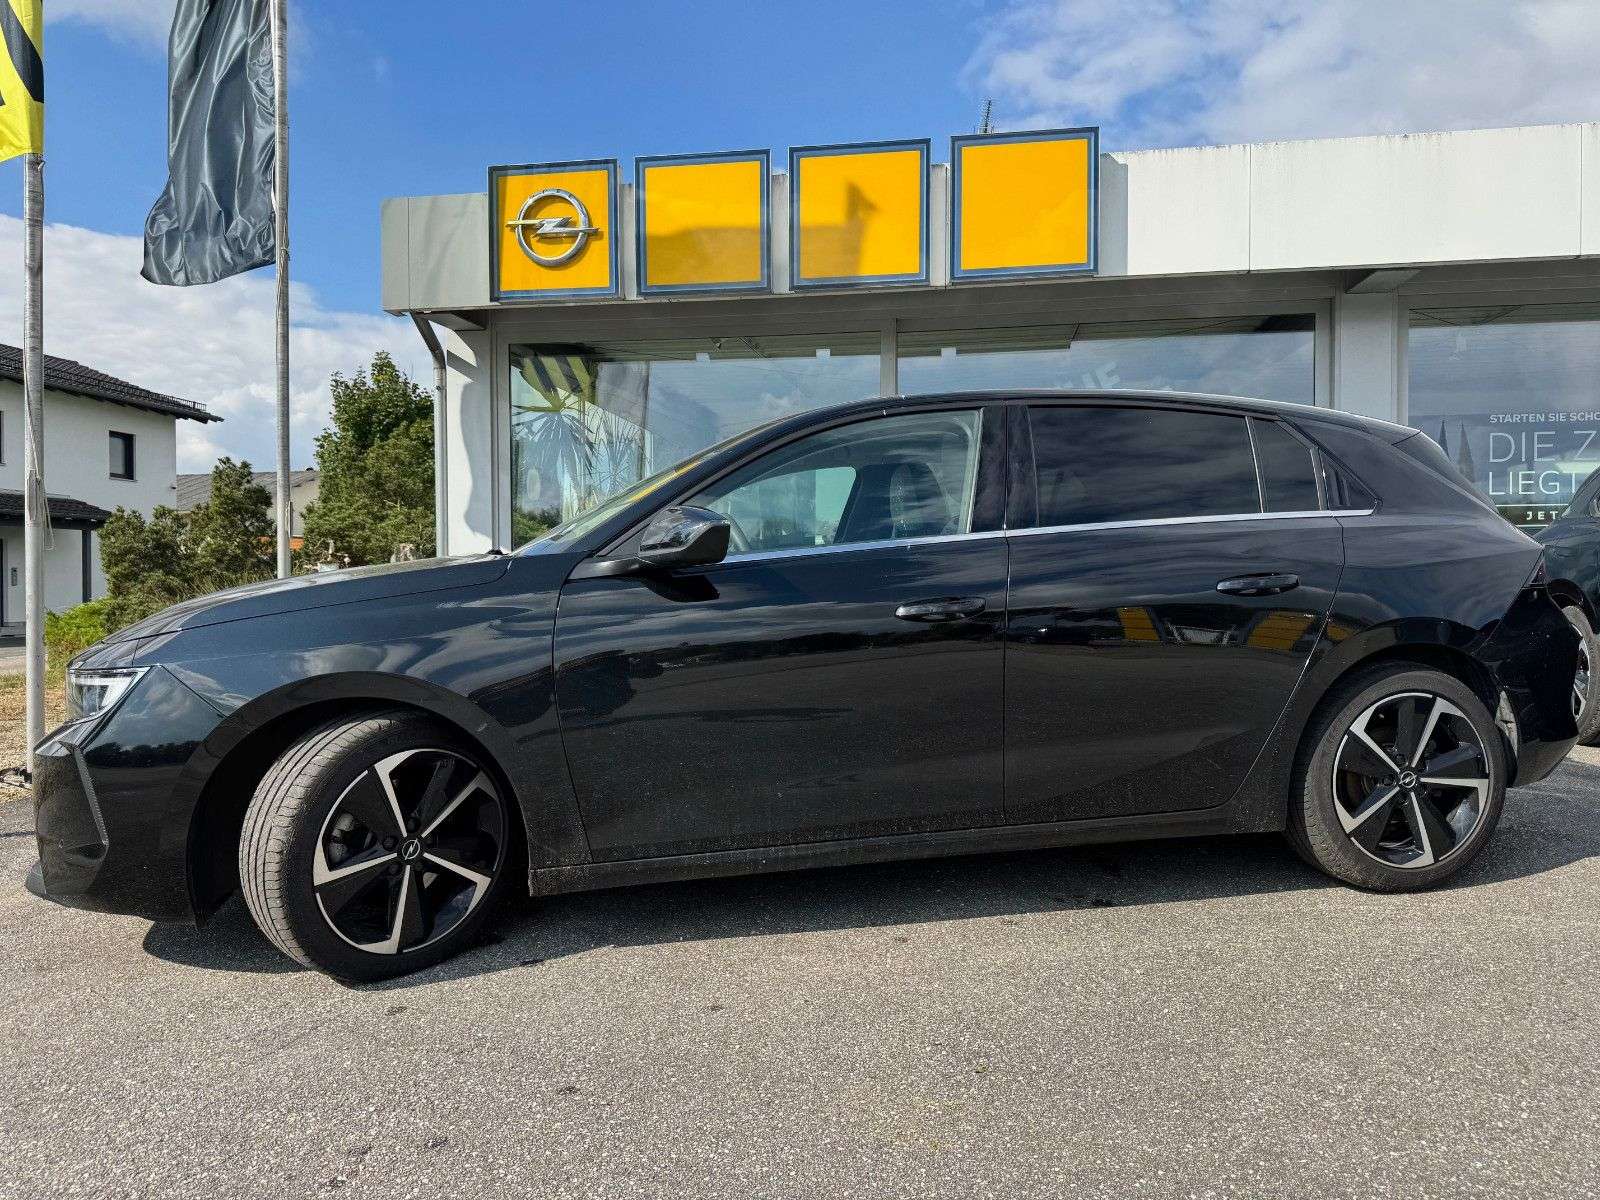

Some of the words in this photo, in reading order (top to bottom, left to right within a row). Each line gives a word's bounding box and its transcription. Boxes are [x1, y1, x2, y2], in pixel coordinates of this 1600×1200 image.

[1489, 413, 1545, 423] STARTEN
[1548, 412, 1567, 422] SIE
[1489, 431, 1556, 463] DIE
[1573, 430, 1598, 461] Z
[1488, 470, 1585, 495] LIEGT
[1526, 511, 1559, 520] JET
